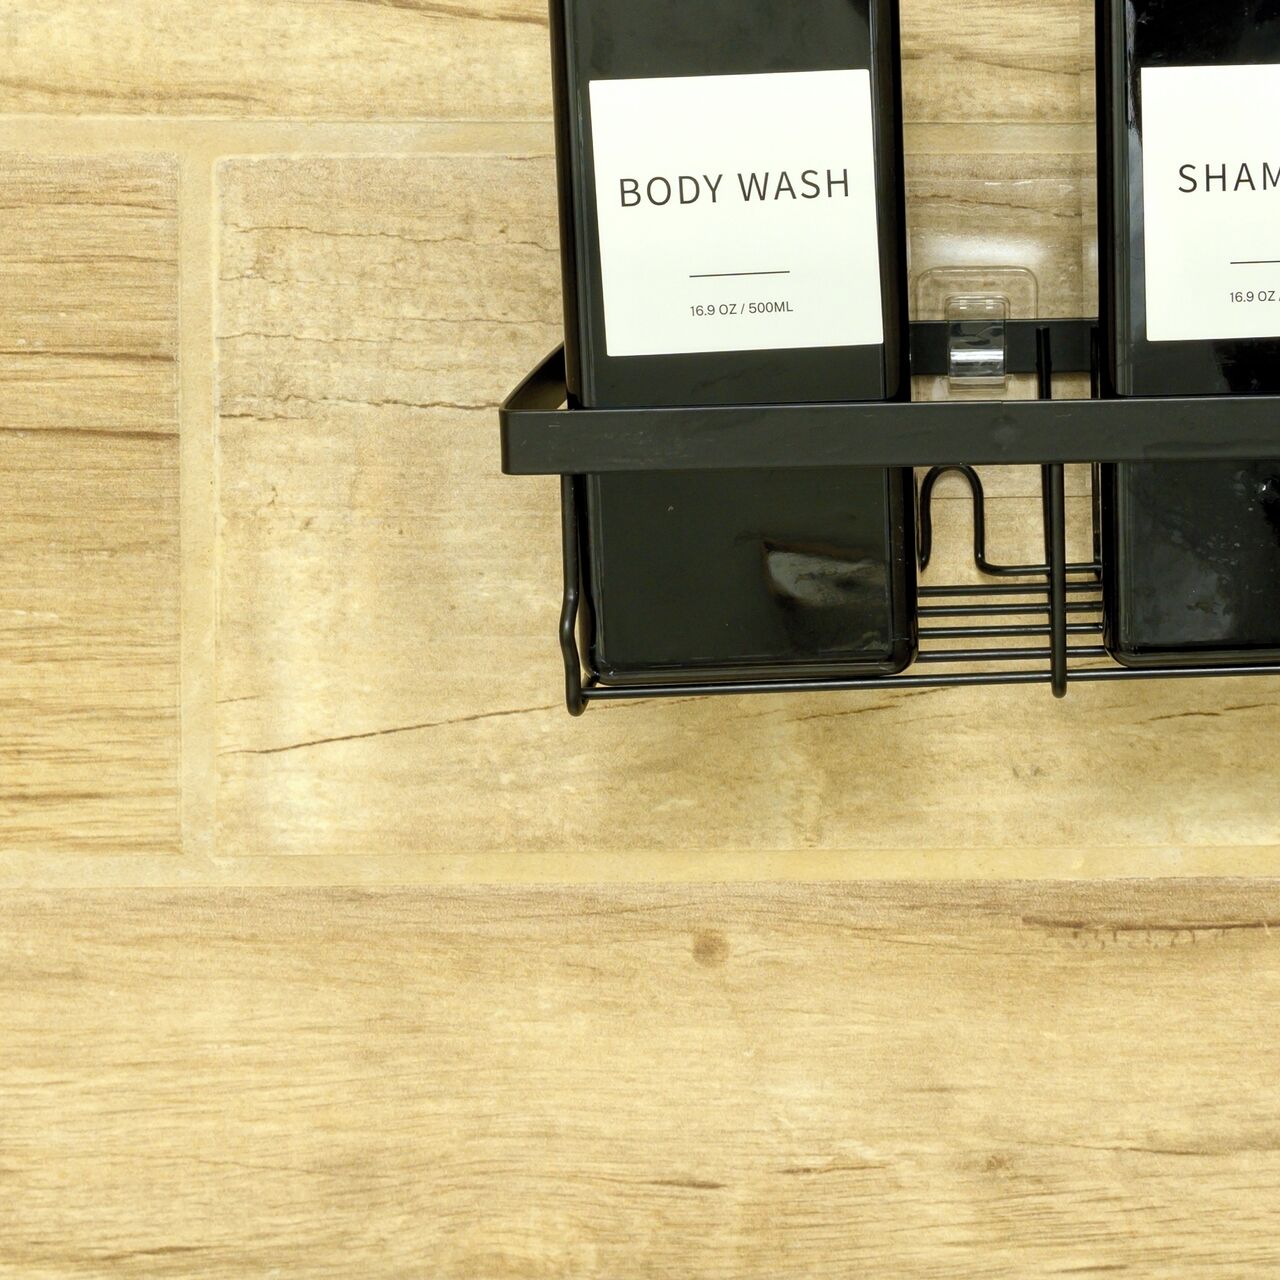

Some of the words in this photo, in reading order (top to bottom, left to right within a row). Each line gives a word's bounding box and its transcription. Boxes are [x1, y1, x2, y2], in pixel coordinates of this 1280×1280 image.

[619, 173, 724, 208] BODY
[736, 168, 849, 202] WASH
[1229, 290, 1255, 303] 16.9
[1257, 290, 1276, 302] OZ
[690, 304, 716, 317] 16.9
[718, 303, 738, 316] OZ
[748, 301, 794, 314] 500ML
